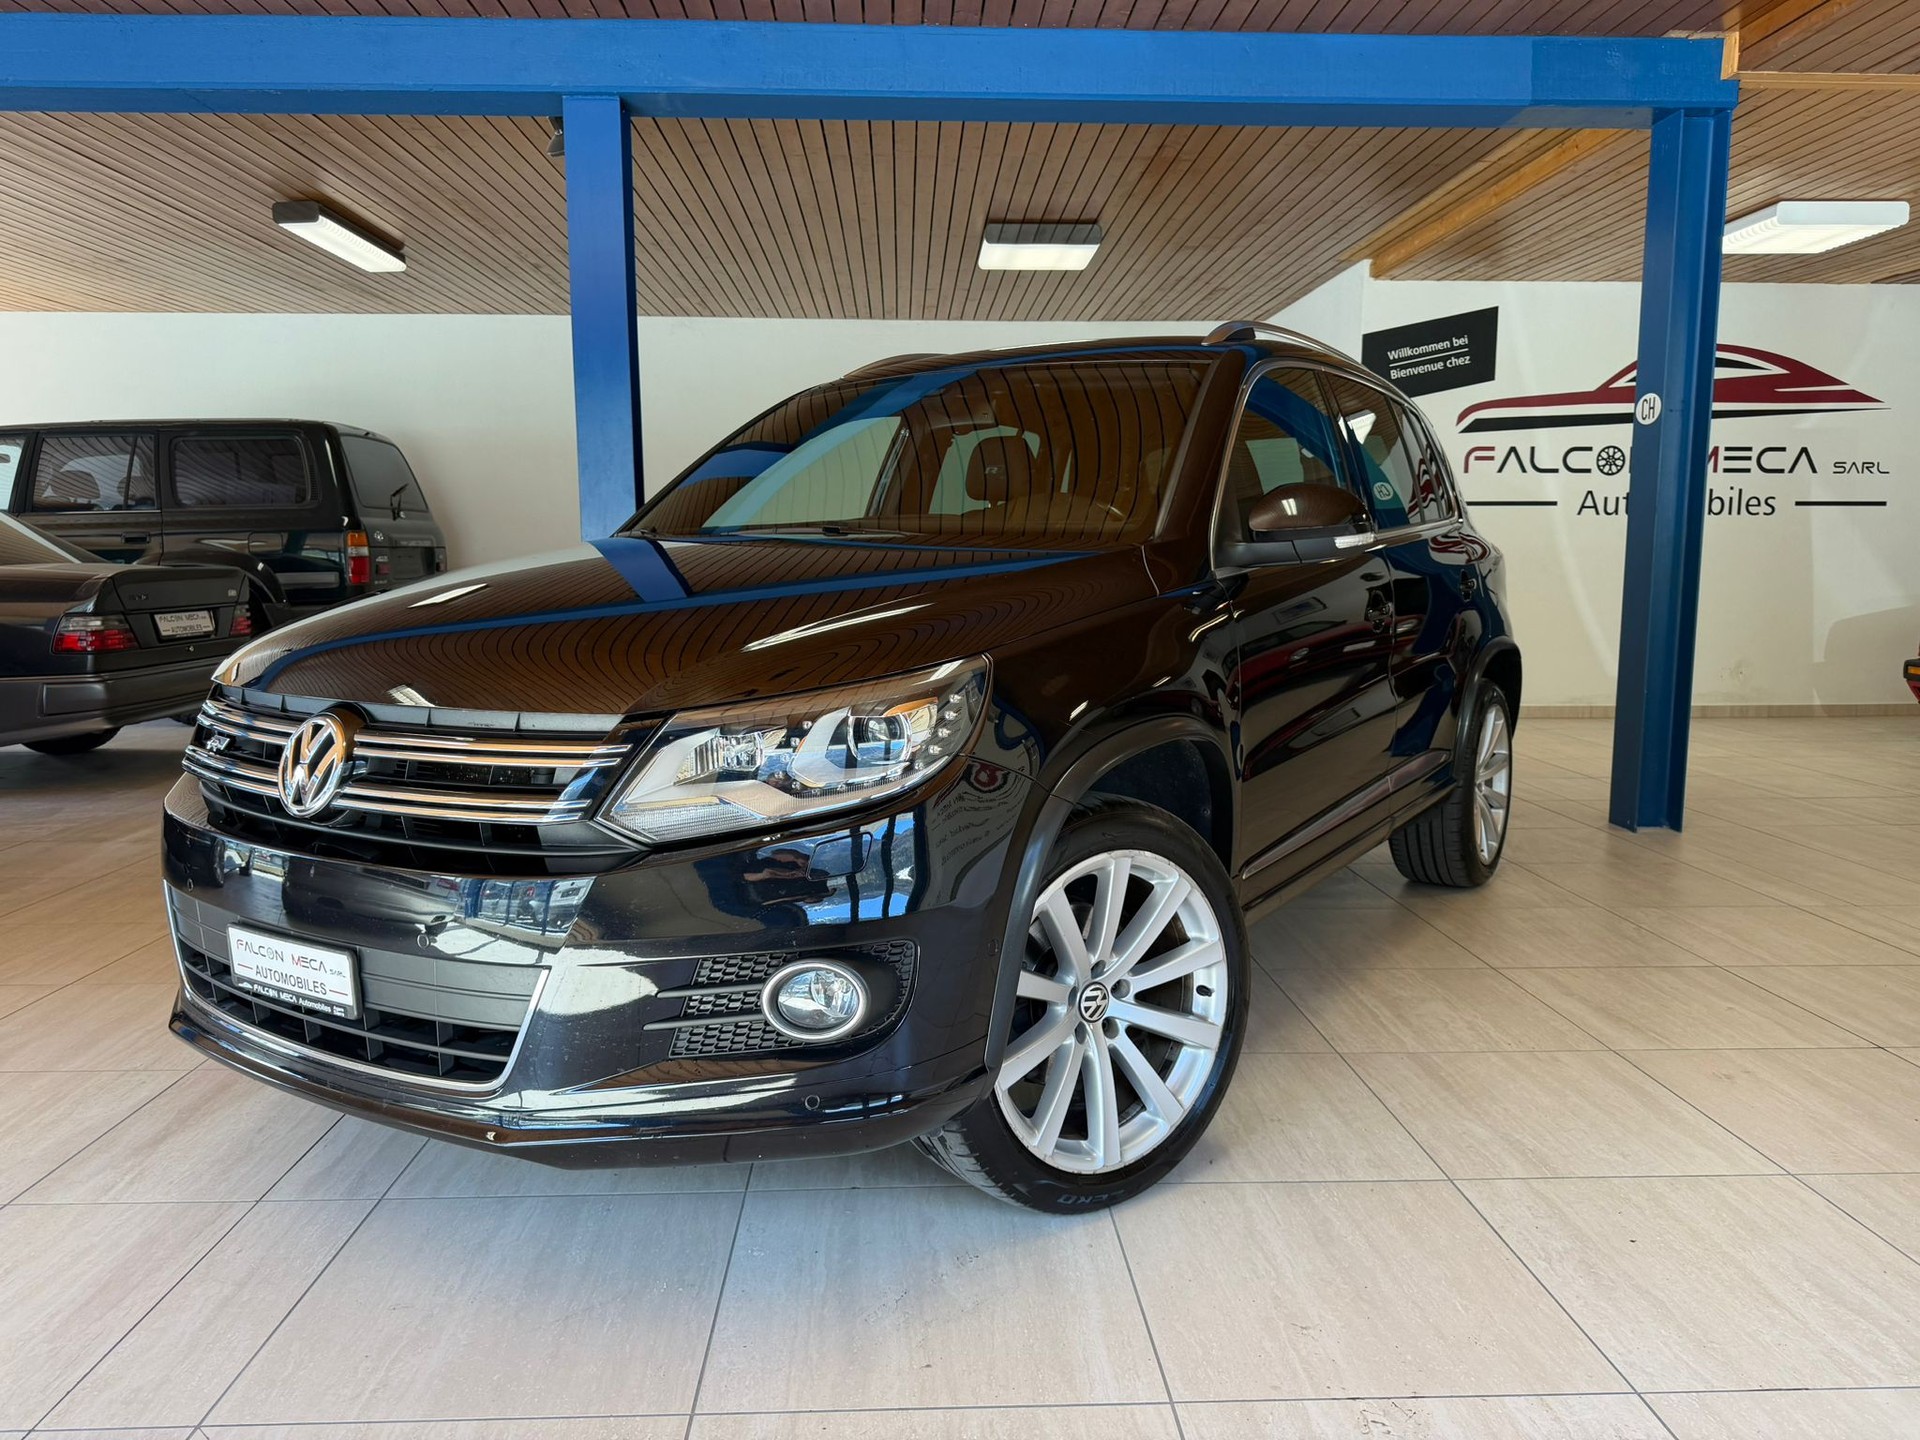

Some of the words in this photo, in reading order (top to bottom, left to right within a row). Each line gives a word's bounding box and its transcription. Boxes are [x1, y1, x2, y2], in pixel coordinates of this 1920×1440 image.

[1387, 340, 1451, 361] Willkommen
[1452, 334, 1469, 347] bei
[1390, 360, 1444, 380] Bienvenue
[1446, 355, 1471, 368] chez
[1641, 396, 1656, 421] CH
[1464, 445, 1633, 476] FALCO
[1832, 461, 1891, 474] SARL
[236, 938, 284, 962] FALCON
[291, 954, 328, 974] MECA
[255, 964, 327, 996] AUTOMOBILES
